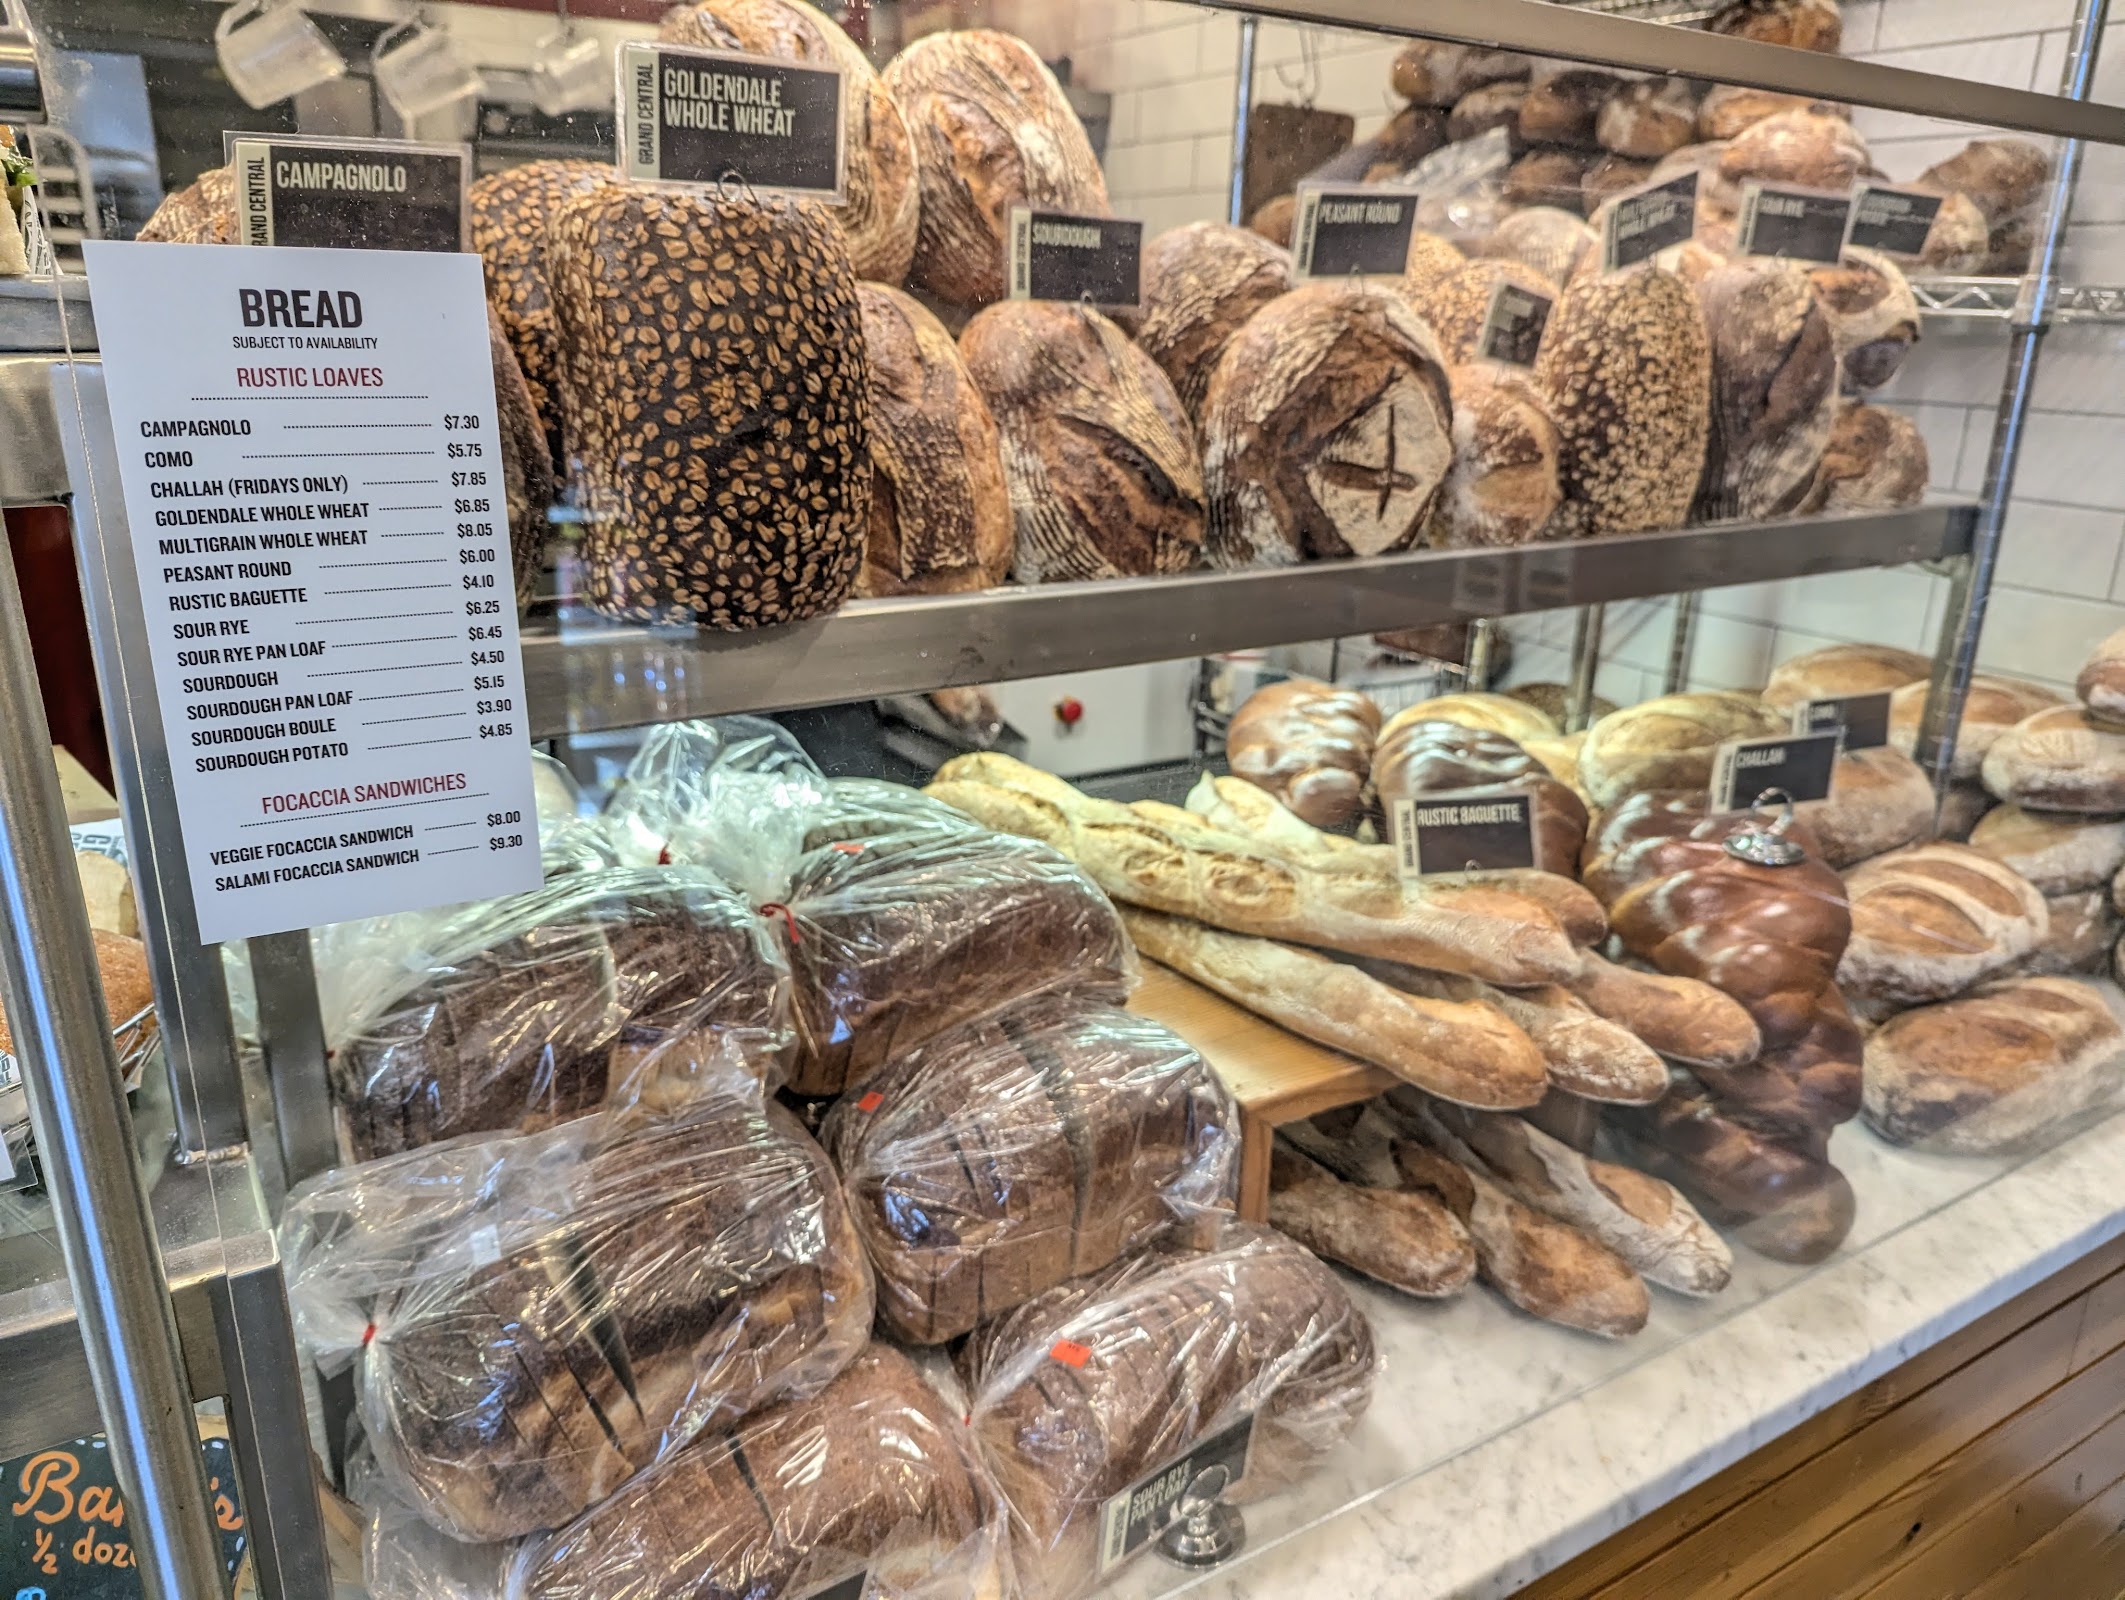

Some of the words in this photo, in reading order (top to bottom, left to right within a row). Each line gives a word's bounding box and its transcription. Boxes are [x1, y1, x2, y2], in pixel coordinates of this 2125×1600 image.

[637, 63, 654, 119] CENTRAL
[664, 67, 782, 108] GOLDENDALE
[664, 98, 729, 132] WHOLE
[733, 105, 796, 137] WHEAT
[638, 124, 654, 165] GRAND
[247, 156, 266, 212] CENTRAL
[276, 160, 407, 193] CAMPAGNOLO
[250, 215, 268, 246] RAND
[239, 289, 362, 328] BREAD
[233, 336, 285, 348] SUBJECT
[288, 337, 303, 348] TO
[306, 337, 378, 349] AVAILABILITY
[237, 368, 307, 387] RUSTIC
[312, 368, 383, 387] LOAVES
[140, 420, 251, 438] CAMPAGNOLO
[444, 414, 479, 431] $7.30
[144, 451, 193, 468] COMO
[448, 442, 482, 459] $5.75
[150, 480, 224, 498] CHALLAH
[228, 478, 299, 498] (FRIDAYS
[302, 475, 348, 494] ONLY)
[452, 471, 486, 487] $7.85
[155, 507, 258, 526] GOLDENDALE
[260, 505, 315, 522] WHOLE
[317, 503, 369, 519] WHEAT
[454, 498, 490, 514] $6.85
[159, 535, 256, 555] MULTIGRAIN
[258, 532, 314, 549] WHOLE
[316, 530, 368, 546] WHEAT
[457, 523, 492, 539] $8.05
[163, 564, 234, 583] PEASANT
[238, 562, 292, 578] ROUND
[460, 549, 495, 564] $6.00
[169, 593, 226, 611] RUSTIC
[230, 588, 308, 607] BAGUETTE
[463, 574, 494, 590] $4.10
[173, 622, 217, 639] SOUR
[219, 620, 250, 636] RYE
[466, 600, 500, 616] $6.25
[177, 650, 221, 666] SOUR
[223, 646, 254, 662] RYE
[256, 644, 287, 660] PAN
[290, 641, 326, 657] LOAF
[468, 626, 502, 642] $6.45
[183, 671, 278, 693] SOURDOUGH
[471, 650, 504, 666] $4.50
[187, 698, 282, 720] SOURDOUGH
[285, 694, 315, 710] PAN
[318, 690, 353, 707] LOAF
[474, 675, 504, 691] $5.15
[191, 723, 286, 746] SOURDOUGH
[288, 718, 336, 736] BOULE
[476, 699, 512, 715] $3.90
[196, 749, 290, 772] SOURDOUGH
[292, 742, 348, 762] POTATO
[479, 723, 512, 739] $4.85
[262, 788, 350, 814] FOCACCIA
[354, 773, 466, 802] SANDWICHES
[1417, 806, 1459, 827] RUSTIC
[1460, 803, 1521, 825] BAGUETTE
[210, 846, 264, 865] VEGGIE
[266, 836, 338, 858] FOCACCIA
[339, 825, 414, 847] SANDWICH
[487, 811, 520, 827] $8.00
[215, 871, 270, 891] SALAMI
[274, 860, 344, 882] FOCACCIA
[346, 849, 419, 872] SANDWICH
[490, 835, 522, 851] $9.30
